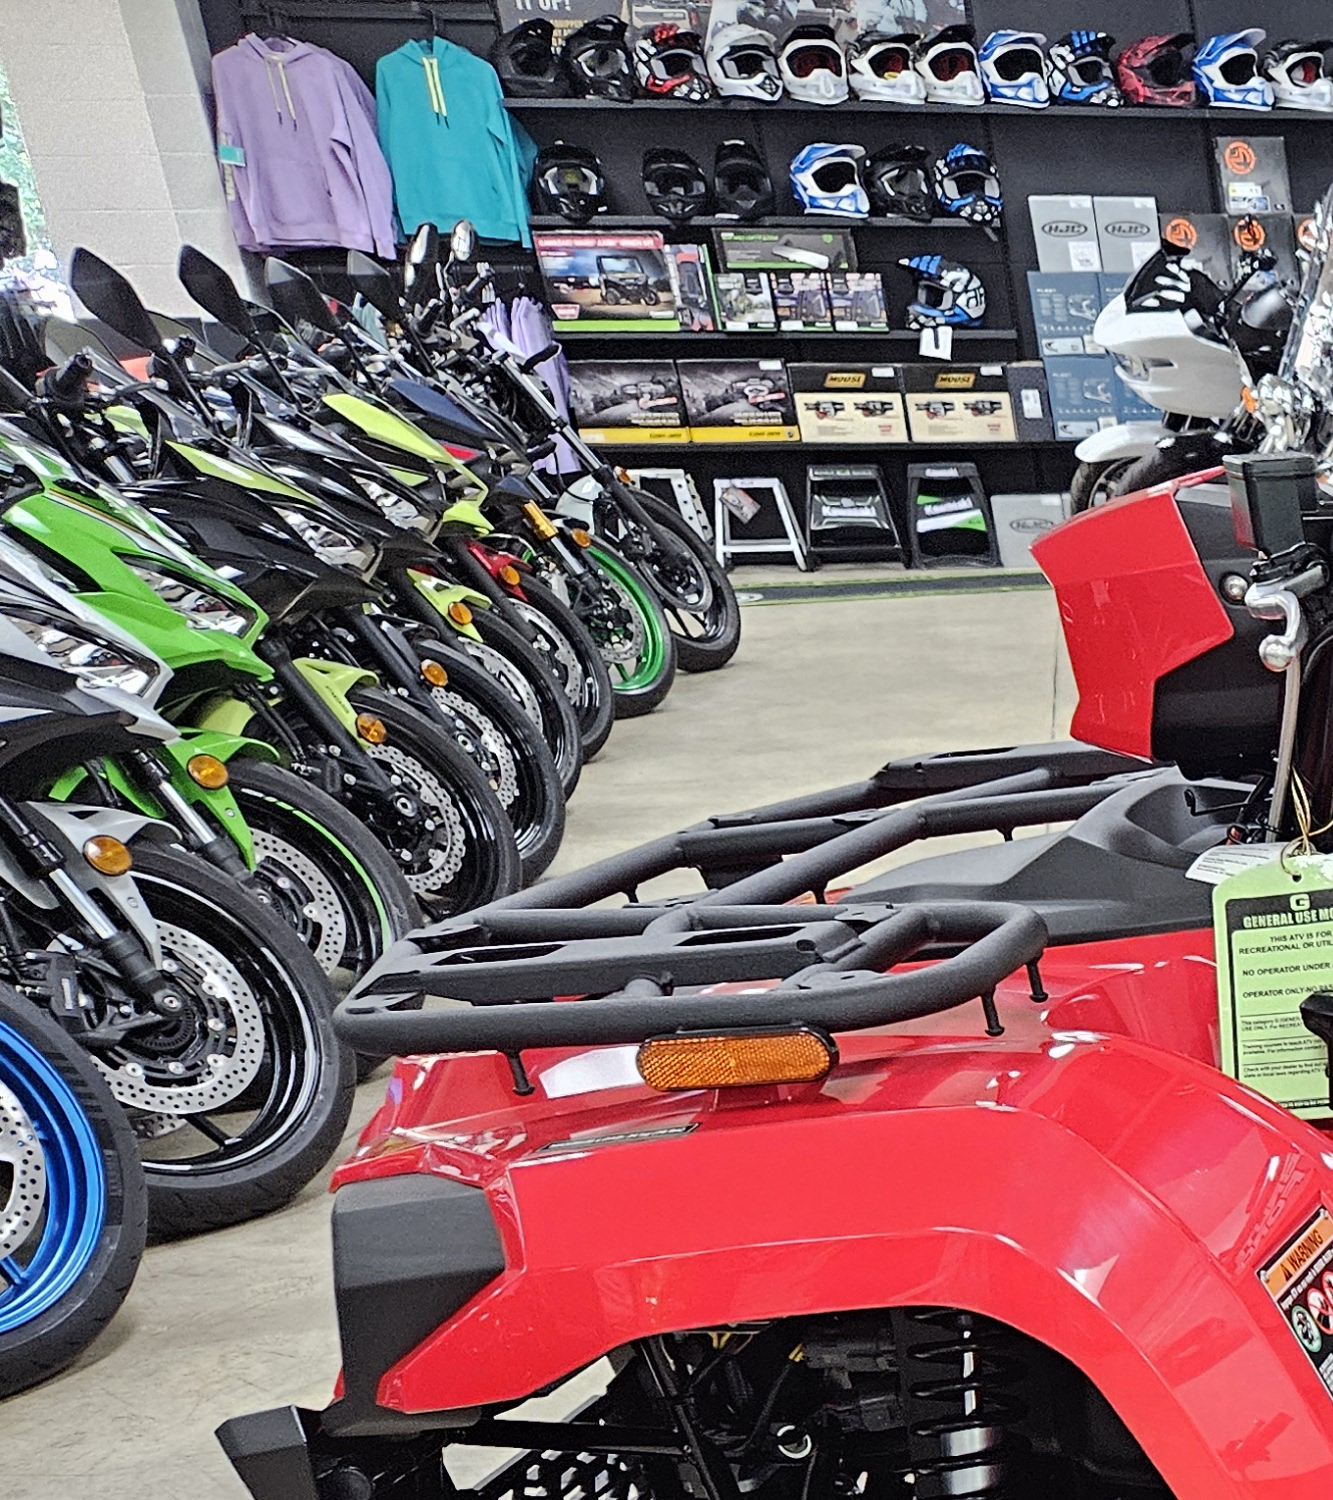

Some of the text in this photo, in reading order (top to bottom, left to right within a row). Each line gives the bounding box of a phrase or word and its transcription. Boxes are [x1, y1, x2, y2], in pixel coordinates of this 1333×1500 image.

[1289, 894, 1310, 911] G
[1243, 911, 1294, 929] GENERAL
[1296, 909, 1318, 924] USE
[1270, 930, 1332, 943] THIS ATV IS FOR
[1238, 943, 1301, 955] RECREATIONAL
[1302, 941, 1315, 949] OR
[1242, 969, 1255, 977] NO
[1257, 965, 1301, 976] OPERATOR
[1303, 962, 1331, 972] UNDER
[1242, 989, 1284, 999] OPERATOR
[1287, 1228, 1323, 1268] WARNING
